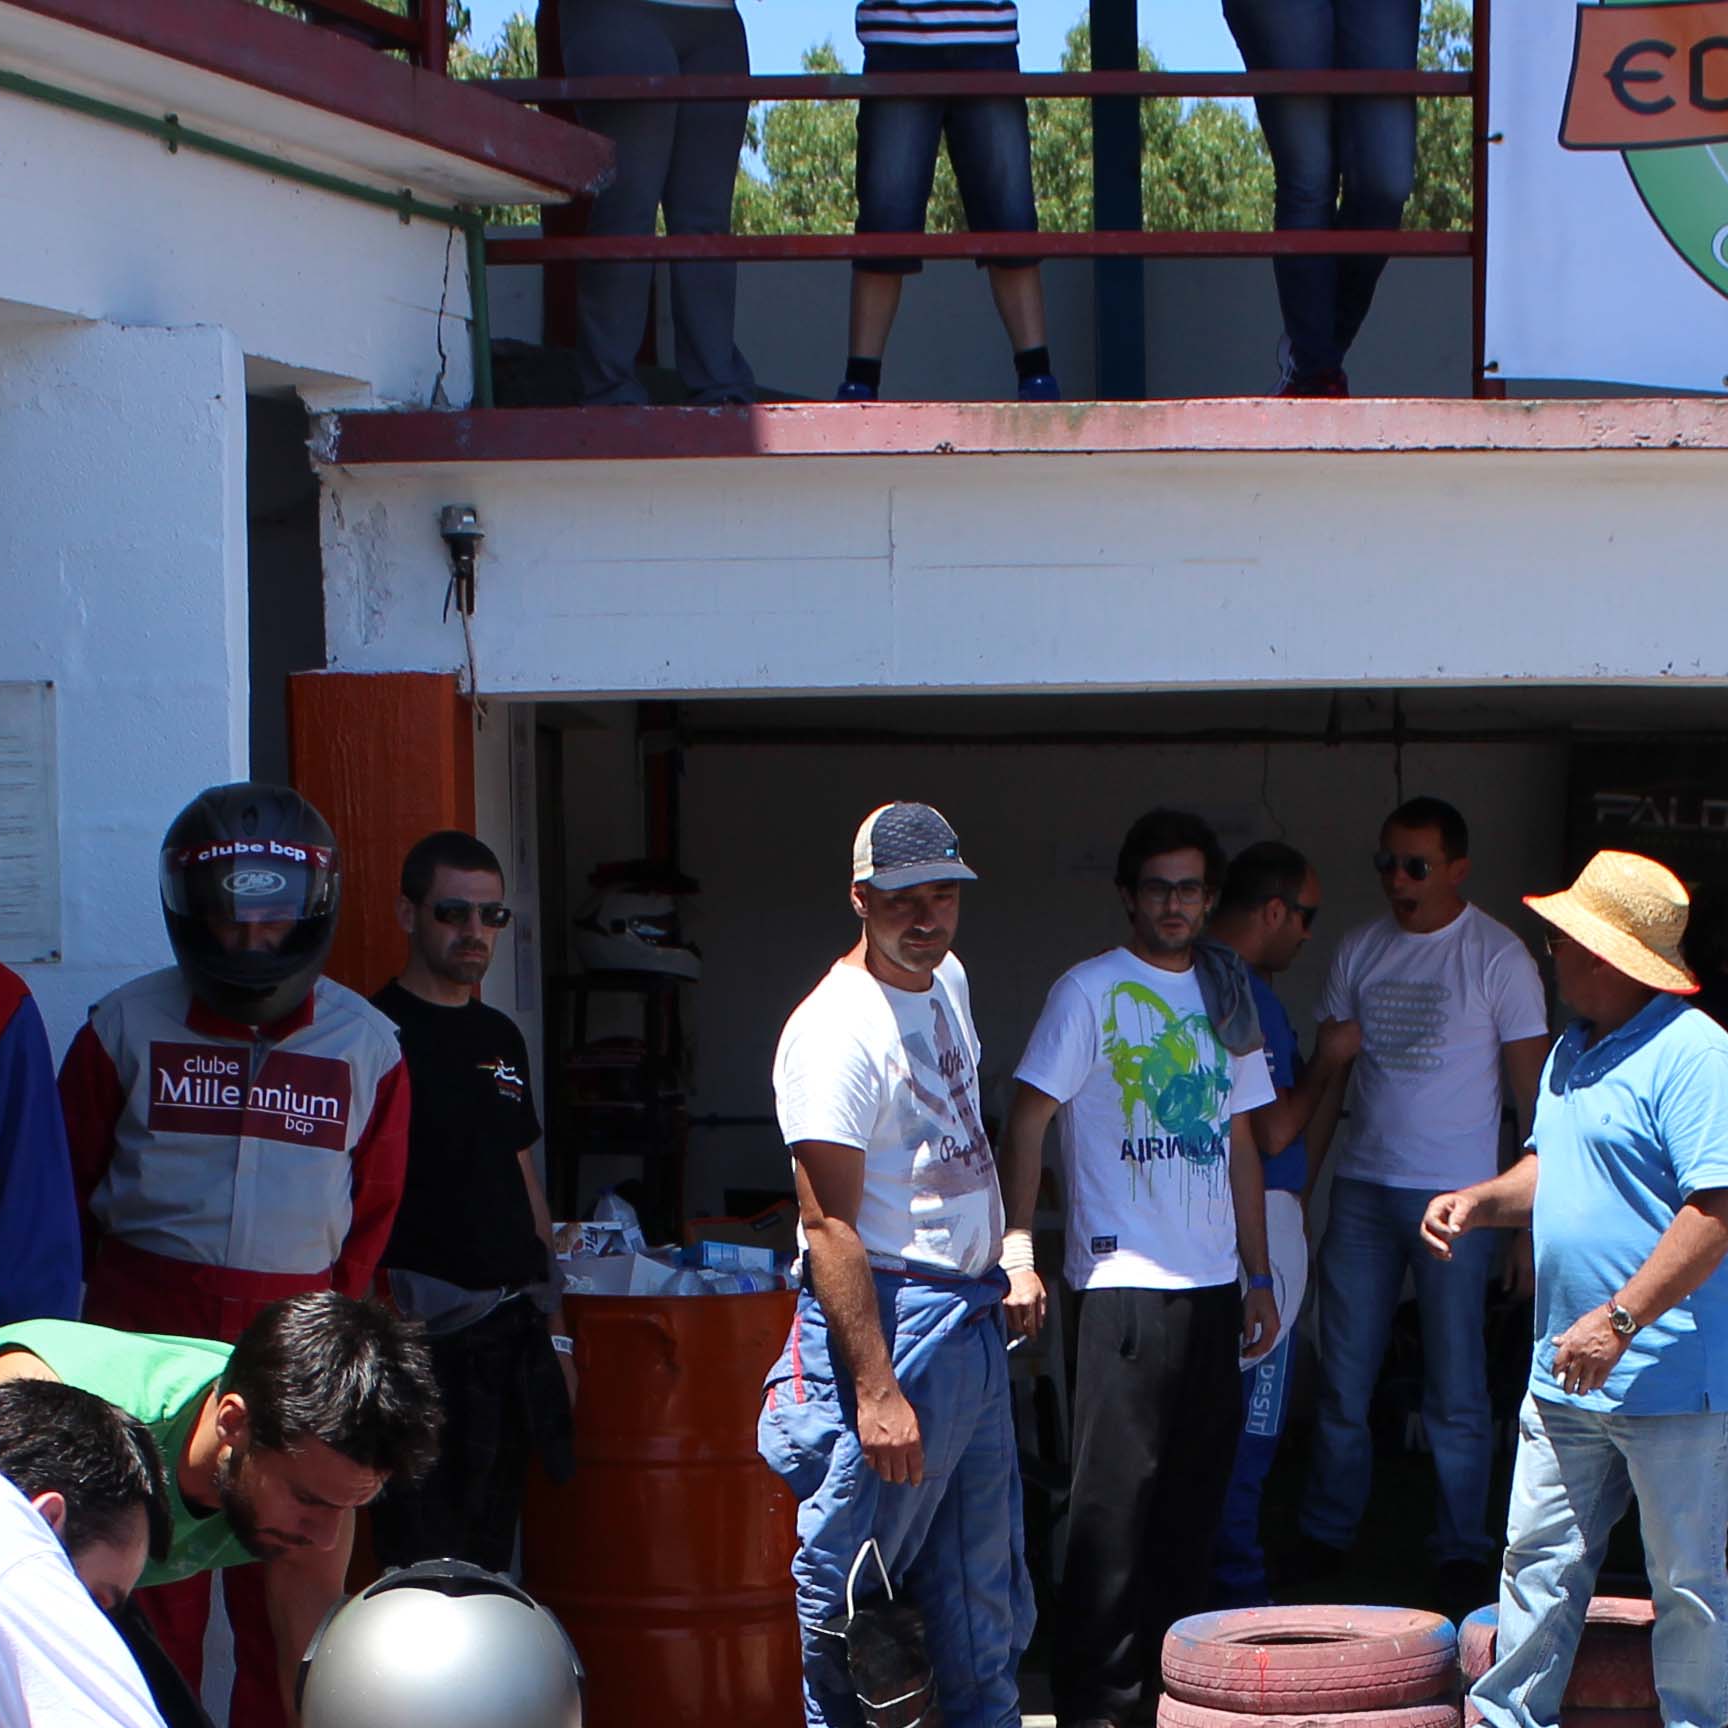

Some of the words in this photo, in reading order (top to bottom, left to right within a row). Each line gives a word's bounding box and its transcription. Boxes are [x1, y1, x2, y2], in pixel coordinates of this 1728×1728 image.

[197, 841, 265, 861] clube
[270, 839, 307, 862] bcp
[183, 1055, 240, 1076] clube
[285, 1115, 315, 1136] bcp
